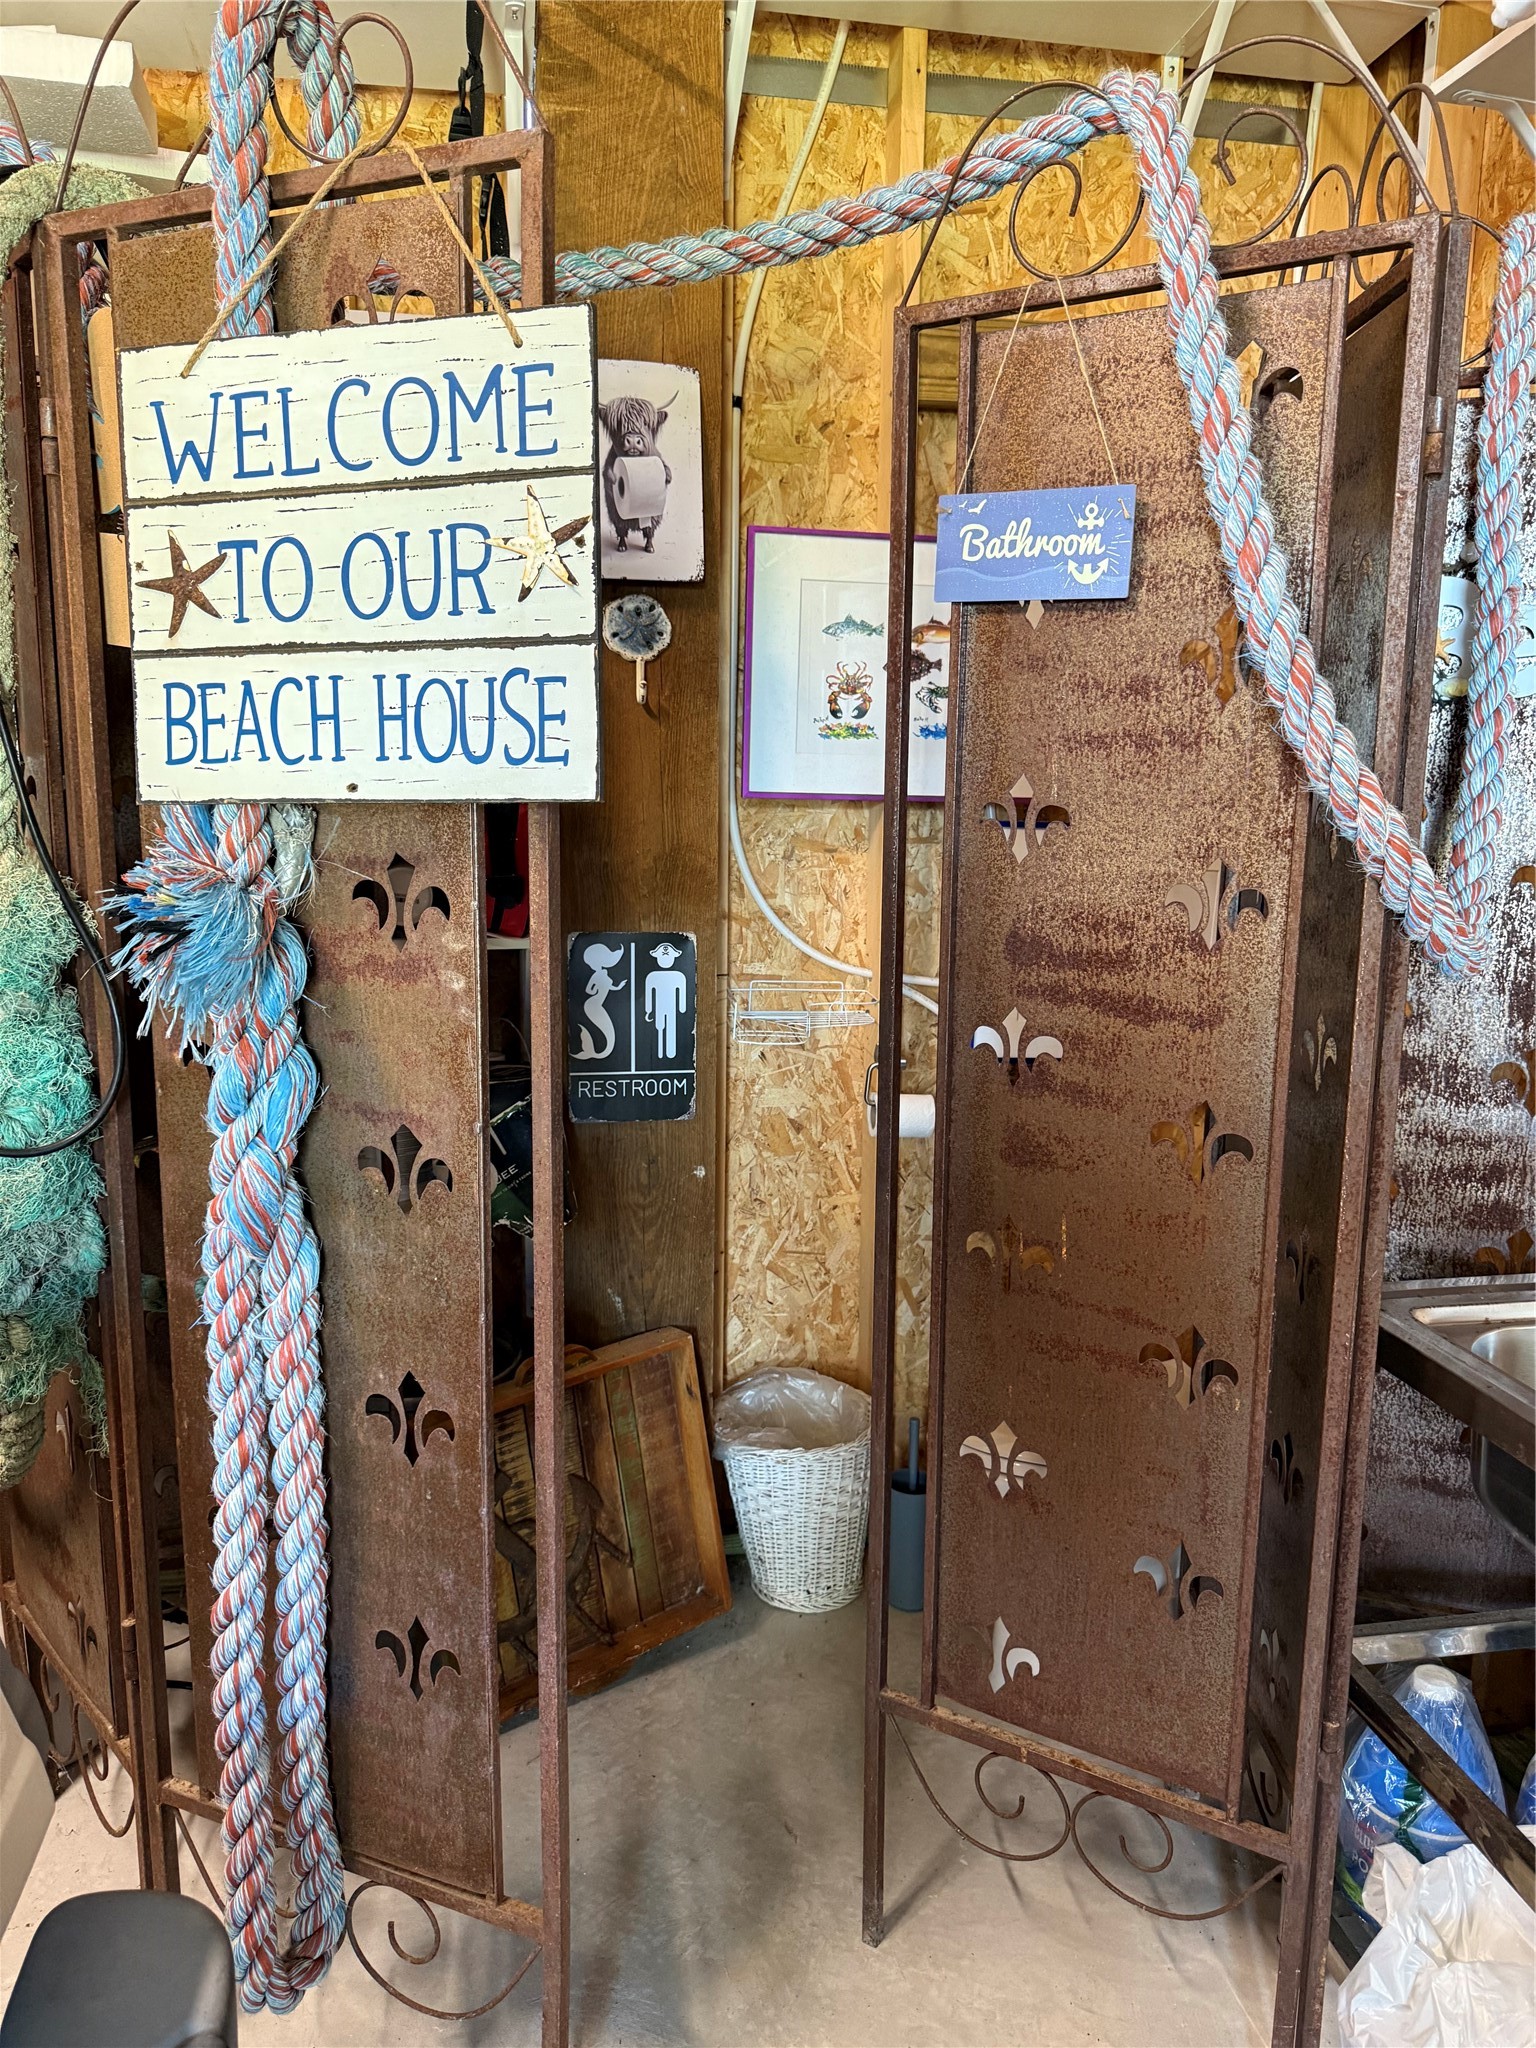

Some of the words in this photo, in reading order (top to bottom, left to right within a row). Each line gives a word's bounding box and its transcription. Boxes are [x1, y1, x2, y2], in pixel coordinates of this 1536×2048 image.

[150, 363, 557, 484] WELCOME
[218, 537, 313, 624] TO
[341, 523, 496, 620] OUR
[960, 517, 1105, 561] Bathroom
[163, 676, 345, 766] BEACH
[373, 667, 569, 766] HOUSE
[578, 1078, 687, 1098] RESTROOM
